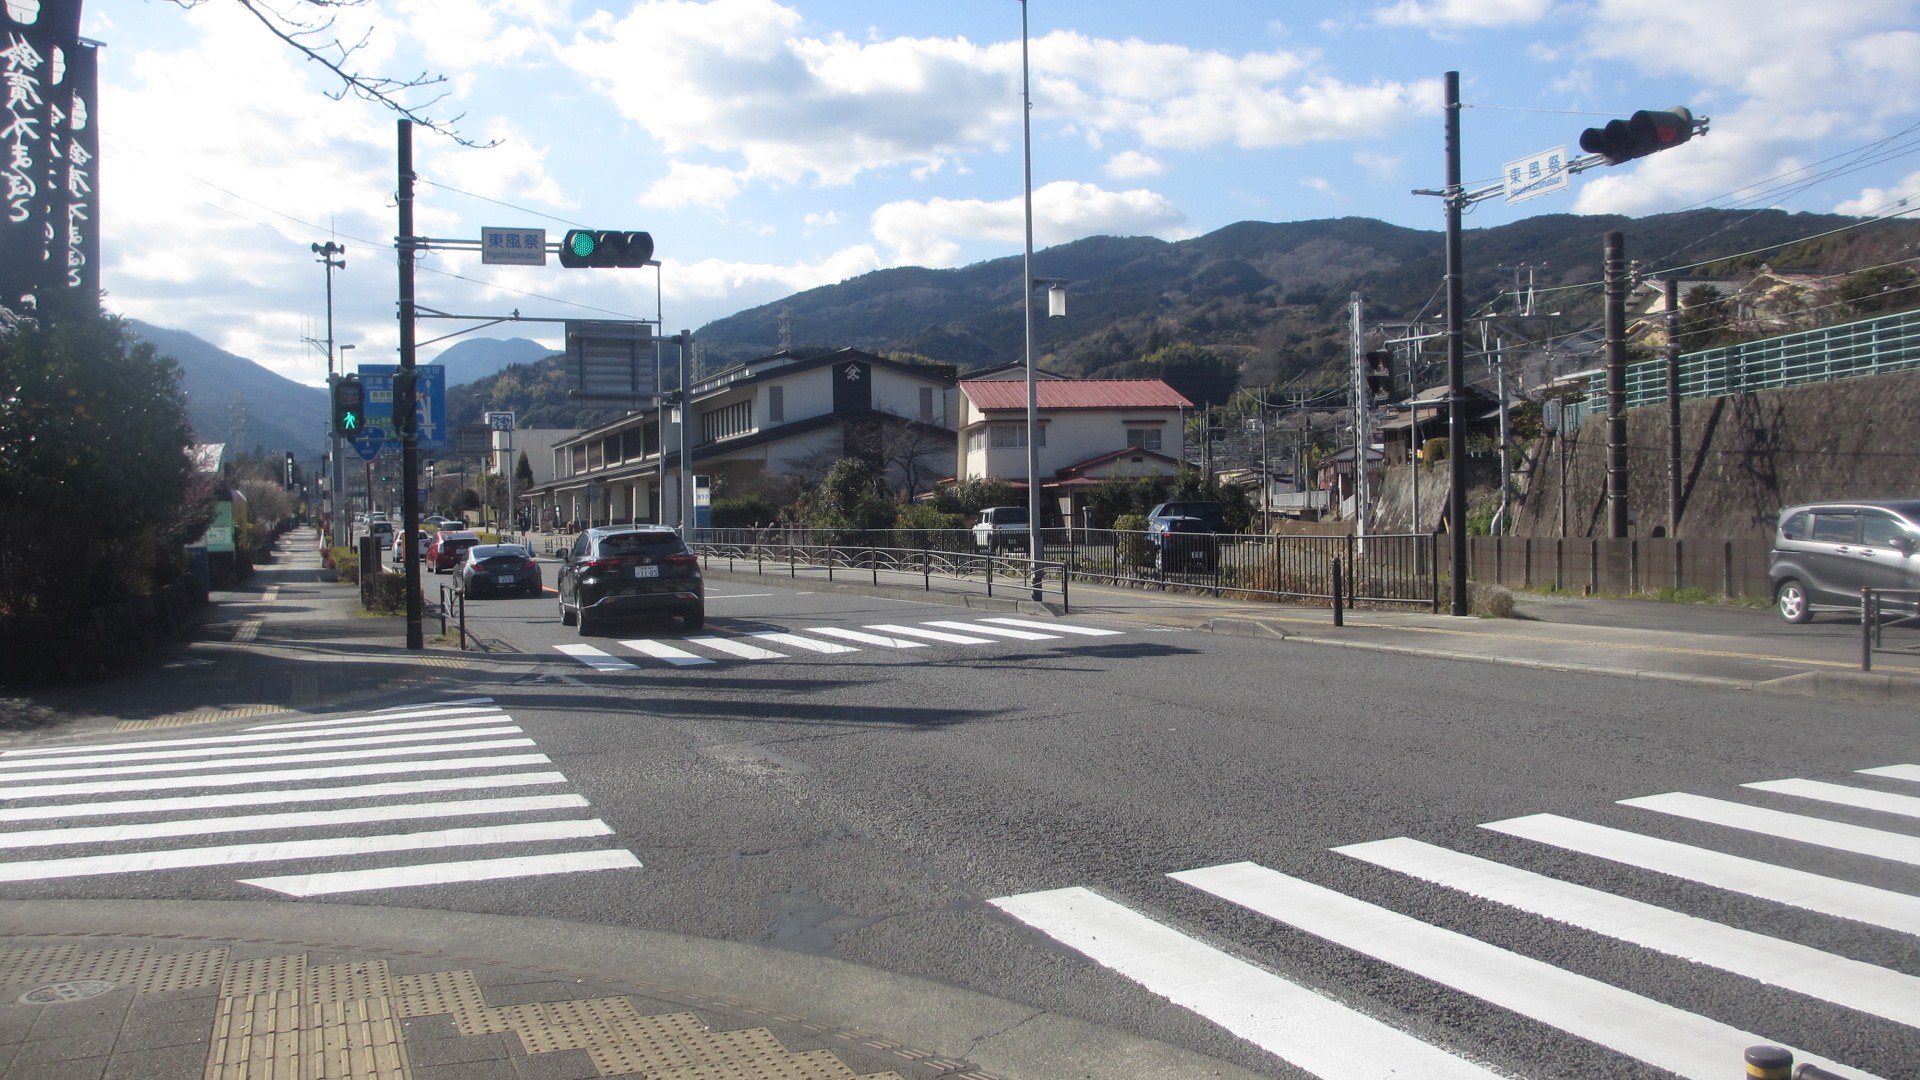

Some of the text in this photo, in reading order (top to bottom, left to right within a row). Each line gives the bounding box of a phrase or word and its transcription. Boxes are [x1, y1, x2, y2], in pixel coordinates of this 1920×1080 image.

[1509, 154, 1560, 186] 東風祭
[488, 232, 540, 249] 東風祭
